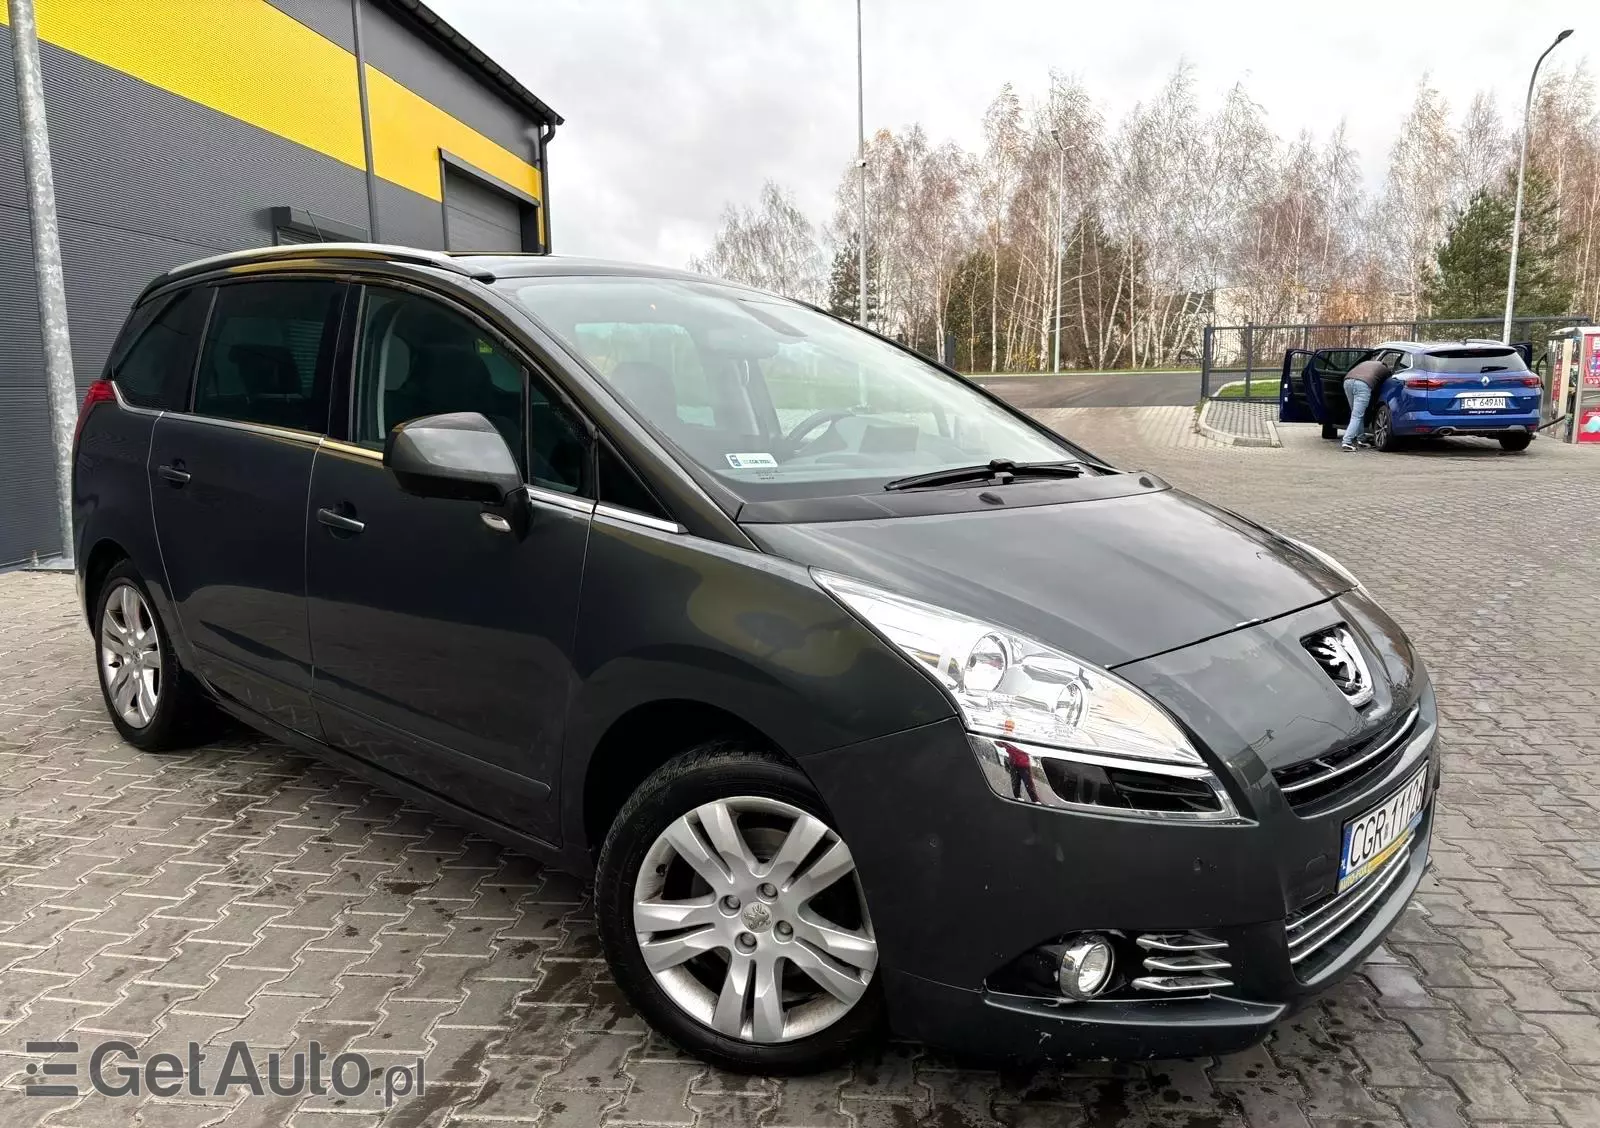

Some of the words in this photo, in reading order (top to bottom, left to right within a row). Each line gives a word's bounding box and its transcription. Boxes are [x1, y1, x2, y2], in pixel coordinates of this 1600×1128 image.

[1466, 399, 1477, 407] CT
[1479, 398, 1504, 407] 649AN
[1350, 808, 1386, 867] CGR
